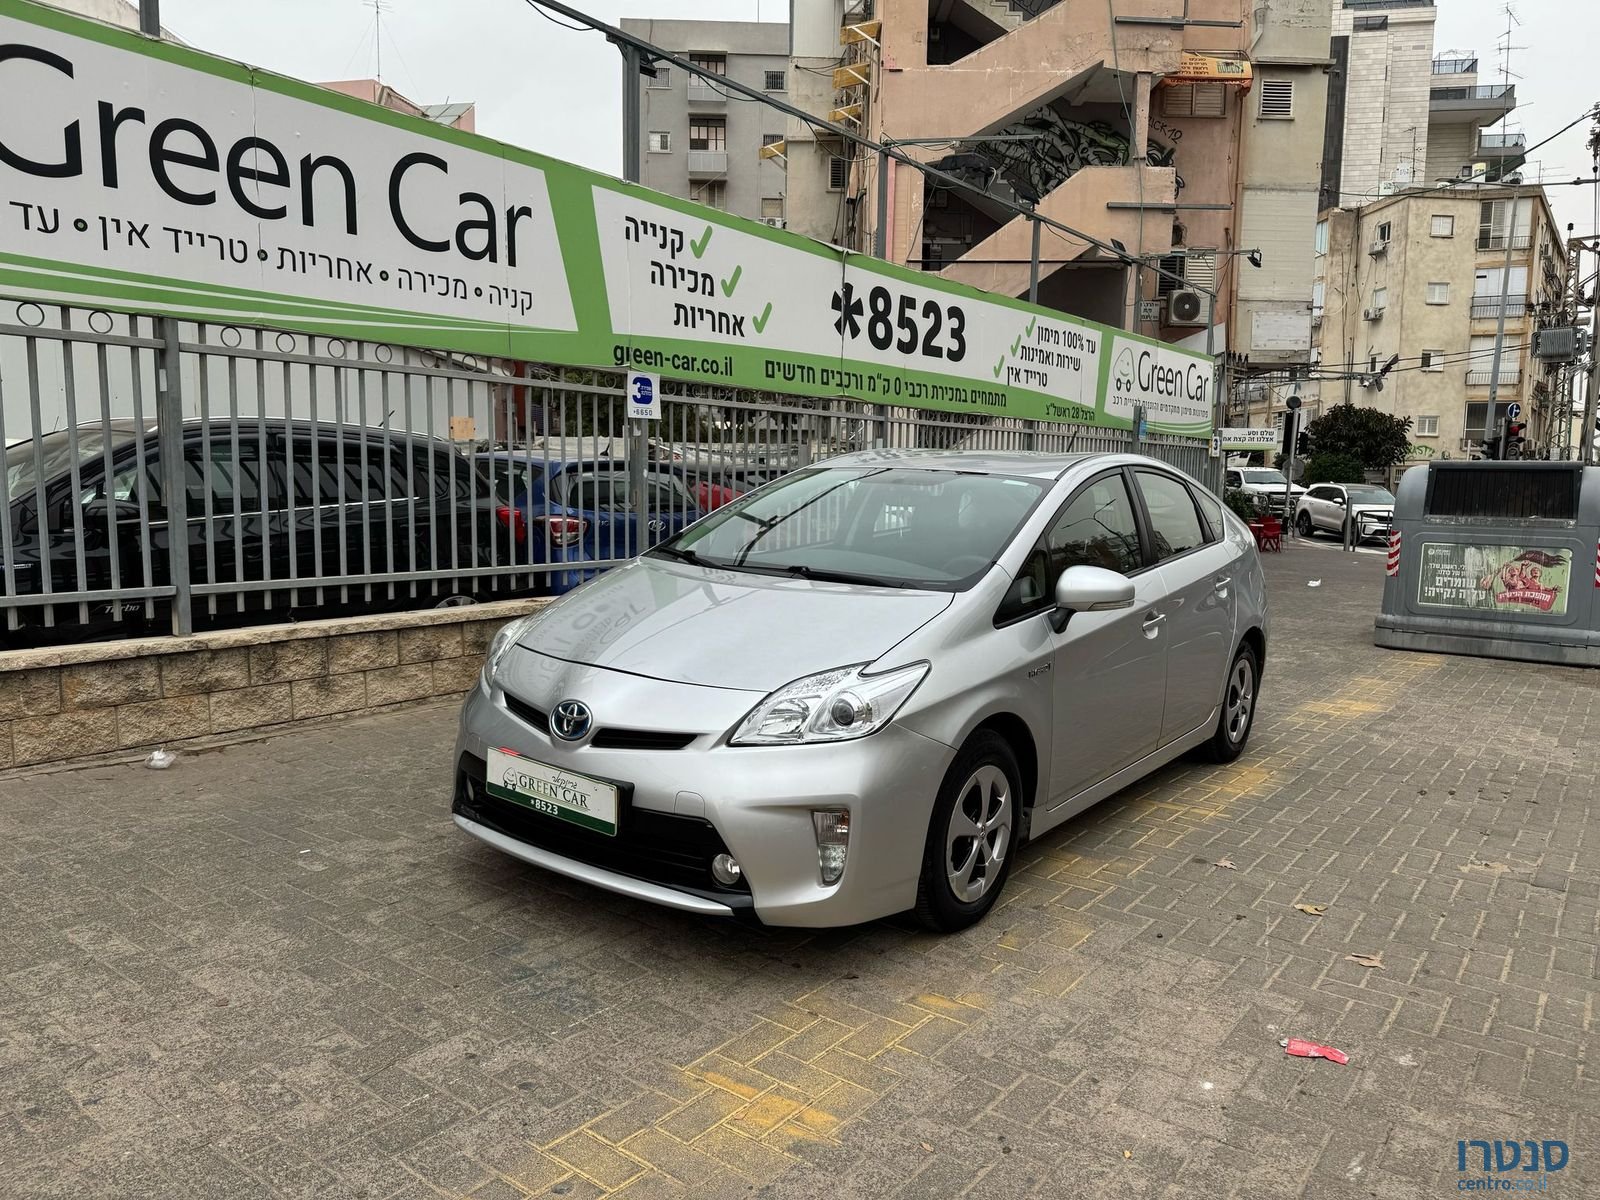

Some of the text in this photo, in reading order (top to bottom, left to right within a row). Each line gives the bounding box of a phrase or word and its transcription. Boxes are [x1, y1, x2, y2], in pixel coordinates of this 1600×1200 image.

[0, 43, 533, 268] Green Car
[625, 215, 684, 260] קנייה
[9, 200, 533, 316] קניה מכירה אחריות טרייד אין עד
[650, 260, 715, 297] מכירה
[673, 302, 745, 338] אחריות
[1037, 325, 1096, 355] עד 100% מימון
[613, 344, 733, 377] green-car.co.il
[1020, 344, 1081, 372] שירות ואמינות
[764, 359, 1007, 408] מתמחים במכירת רכבי 0 ק"מ ורכבים חדשים
[1007, 365, 1048, 388] טרייד אין
[1138, 350, 1209, 402] Green Car
[1071, 406, 1080, 419] 28
[1080, 406, 1095, 421] הרצל
[1112, 395, 1122, 406] רכב
[1424, 586, 1457, 599] נקייה!
[1435, 576, 1477, 589] שומרים
[519, 774, 588, 809] GREEN CAR
